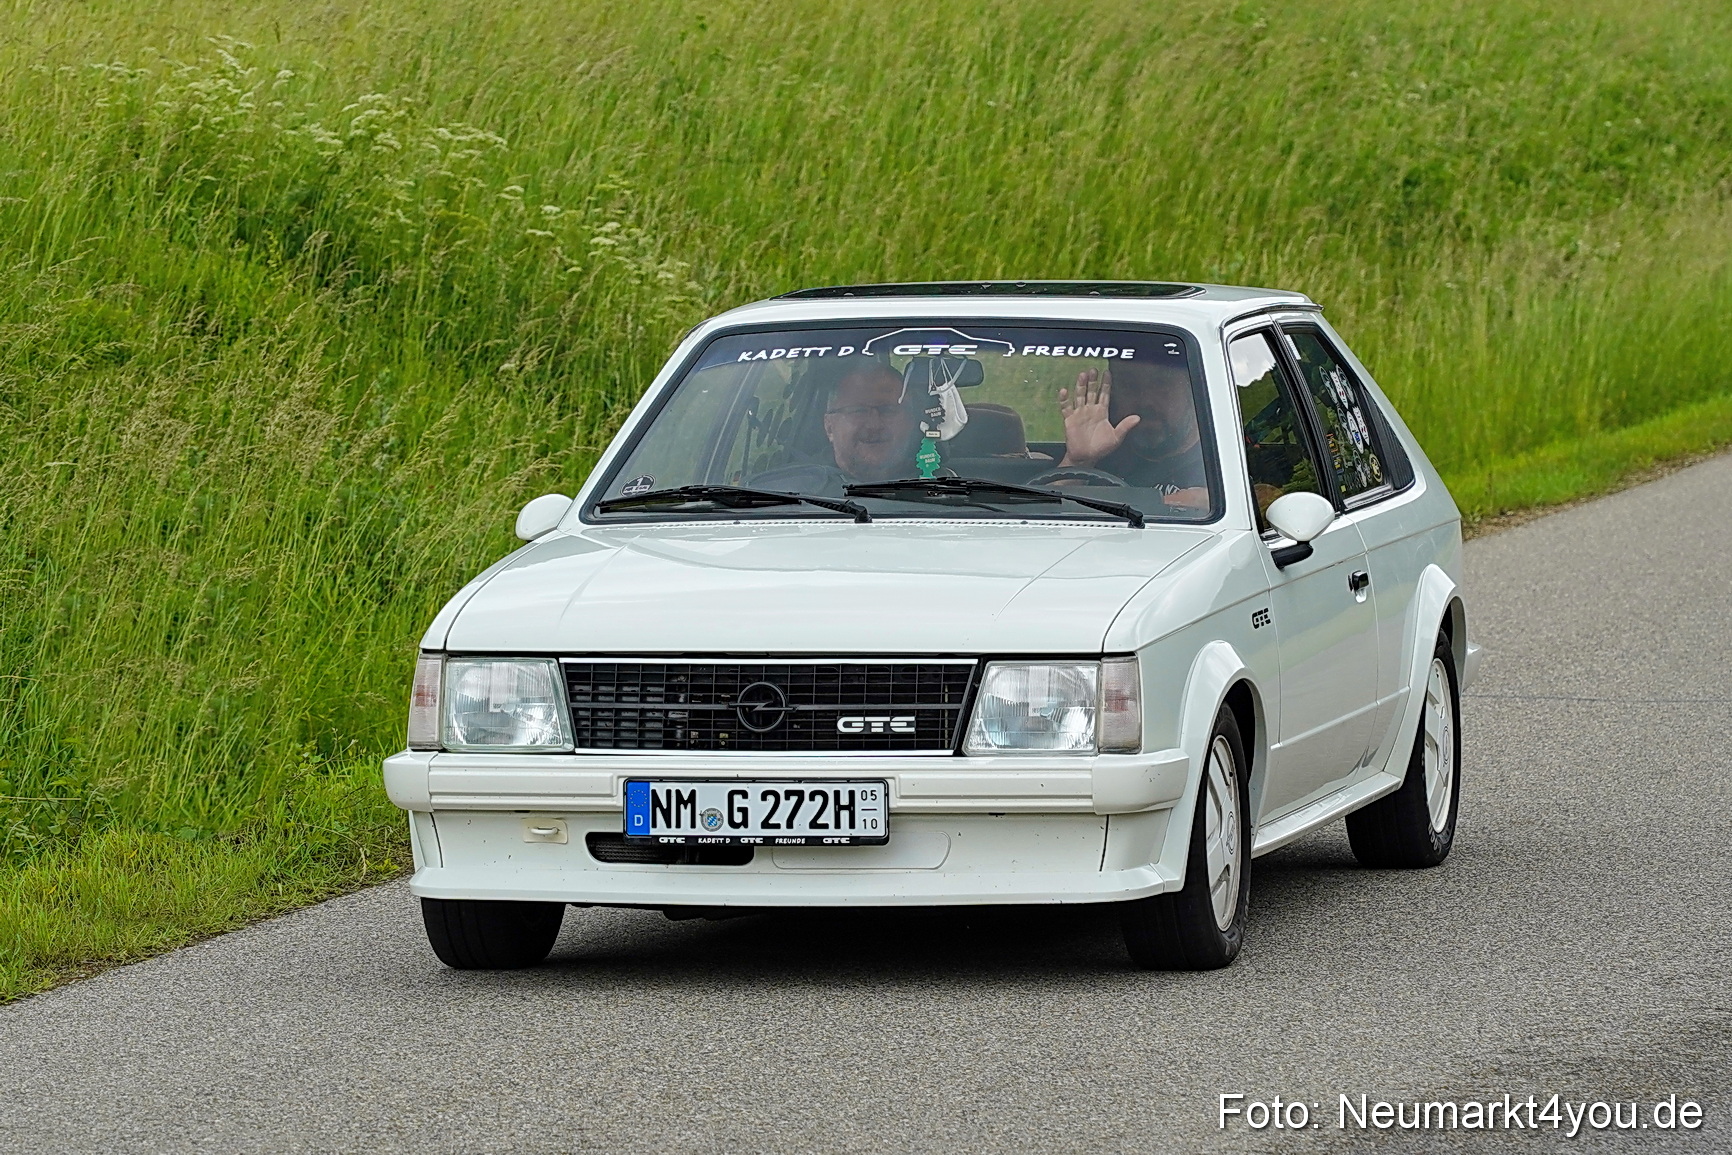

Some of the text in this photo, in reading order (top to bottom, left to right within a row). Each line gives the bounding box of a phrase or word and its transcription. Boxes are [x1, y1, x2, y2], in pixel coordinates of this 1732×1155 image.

[737, 344, 1135, 363] KADETT D GTE FREUNDE
[837, 716, 916, 733] GTE
[860, 789, 878, 802] 05
[651, 788, 697, 829] NM
[727, 789, 749, 830] G
[760, 789, 856, 830] 272H
[633, 814, 644, 827] D
[862, 818, 878, 830] 10
